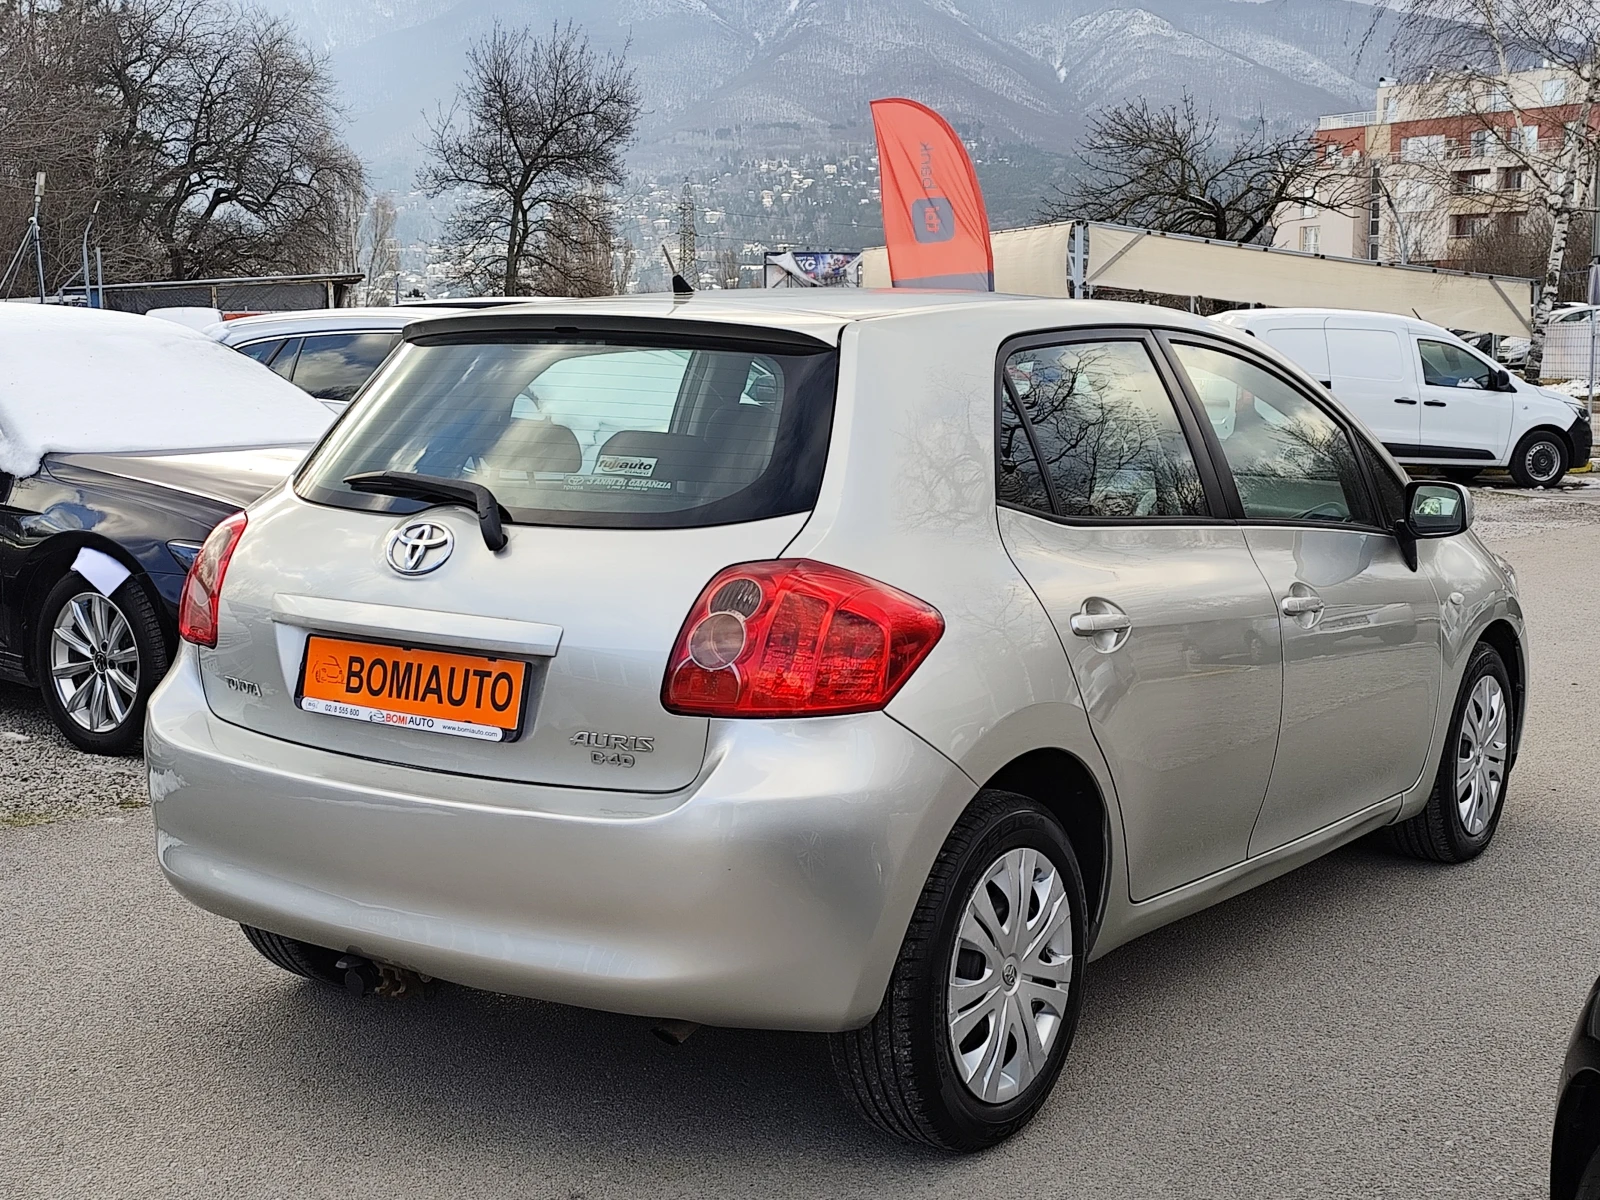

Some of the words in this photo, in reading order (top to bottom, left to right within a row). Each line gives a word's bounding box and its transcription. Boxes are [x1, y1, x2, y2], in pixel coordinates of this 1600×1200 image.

[598, 459, 652, 470] fujiauto
[616, 478, 628, 486] DI
[628, 479, 672, 489] GARANZIA
[345, 655, 514, 712] BOMIAUTO
[442, 724, 498, 738] www.bomiauto.com
[569, 730, 654, 753] AURIS
